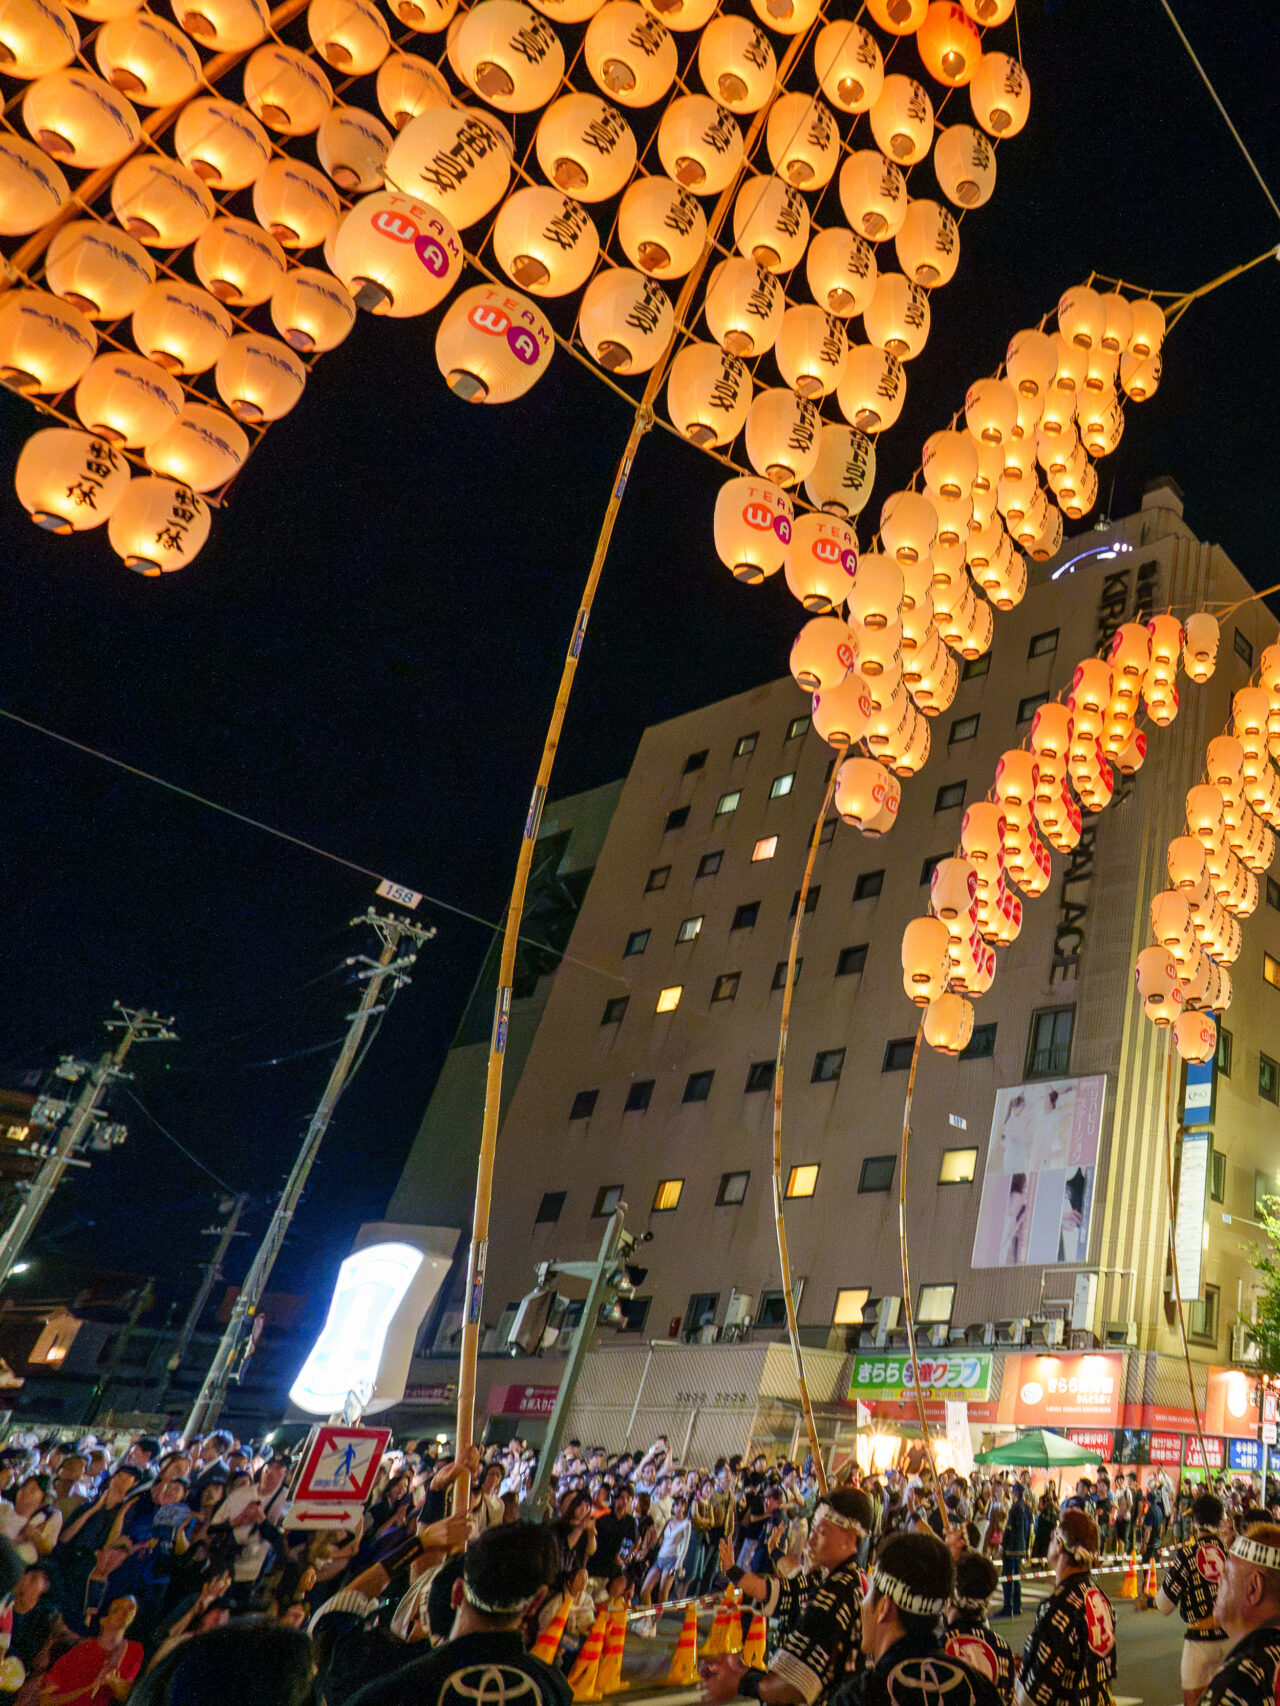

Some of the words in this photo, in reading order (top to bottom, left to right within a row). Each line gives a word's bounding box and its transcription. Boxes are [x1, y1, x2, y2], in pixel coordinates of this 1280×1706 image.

[378, 213, 443, 272] WA
[389, 196, 460, 258] TEAM
[474, 306, 534, 359] WA
[485, 290, 549, 344] TEAM
[746, 508, 790, 544] WA
[815, 546, 857, 572] WA
[386, 884, 414, 904] 158
